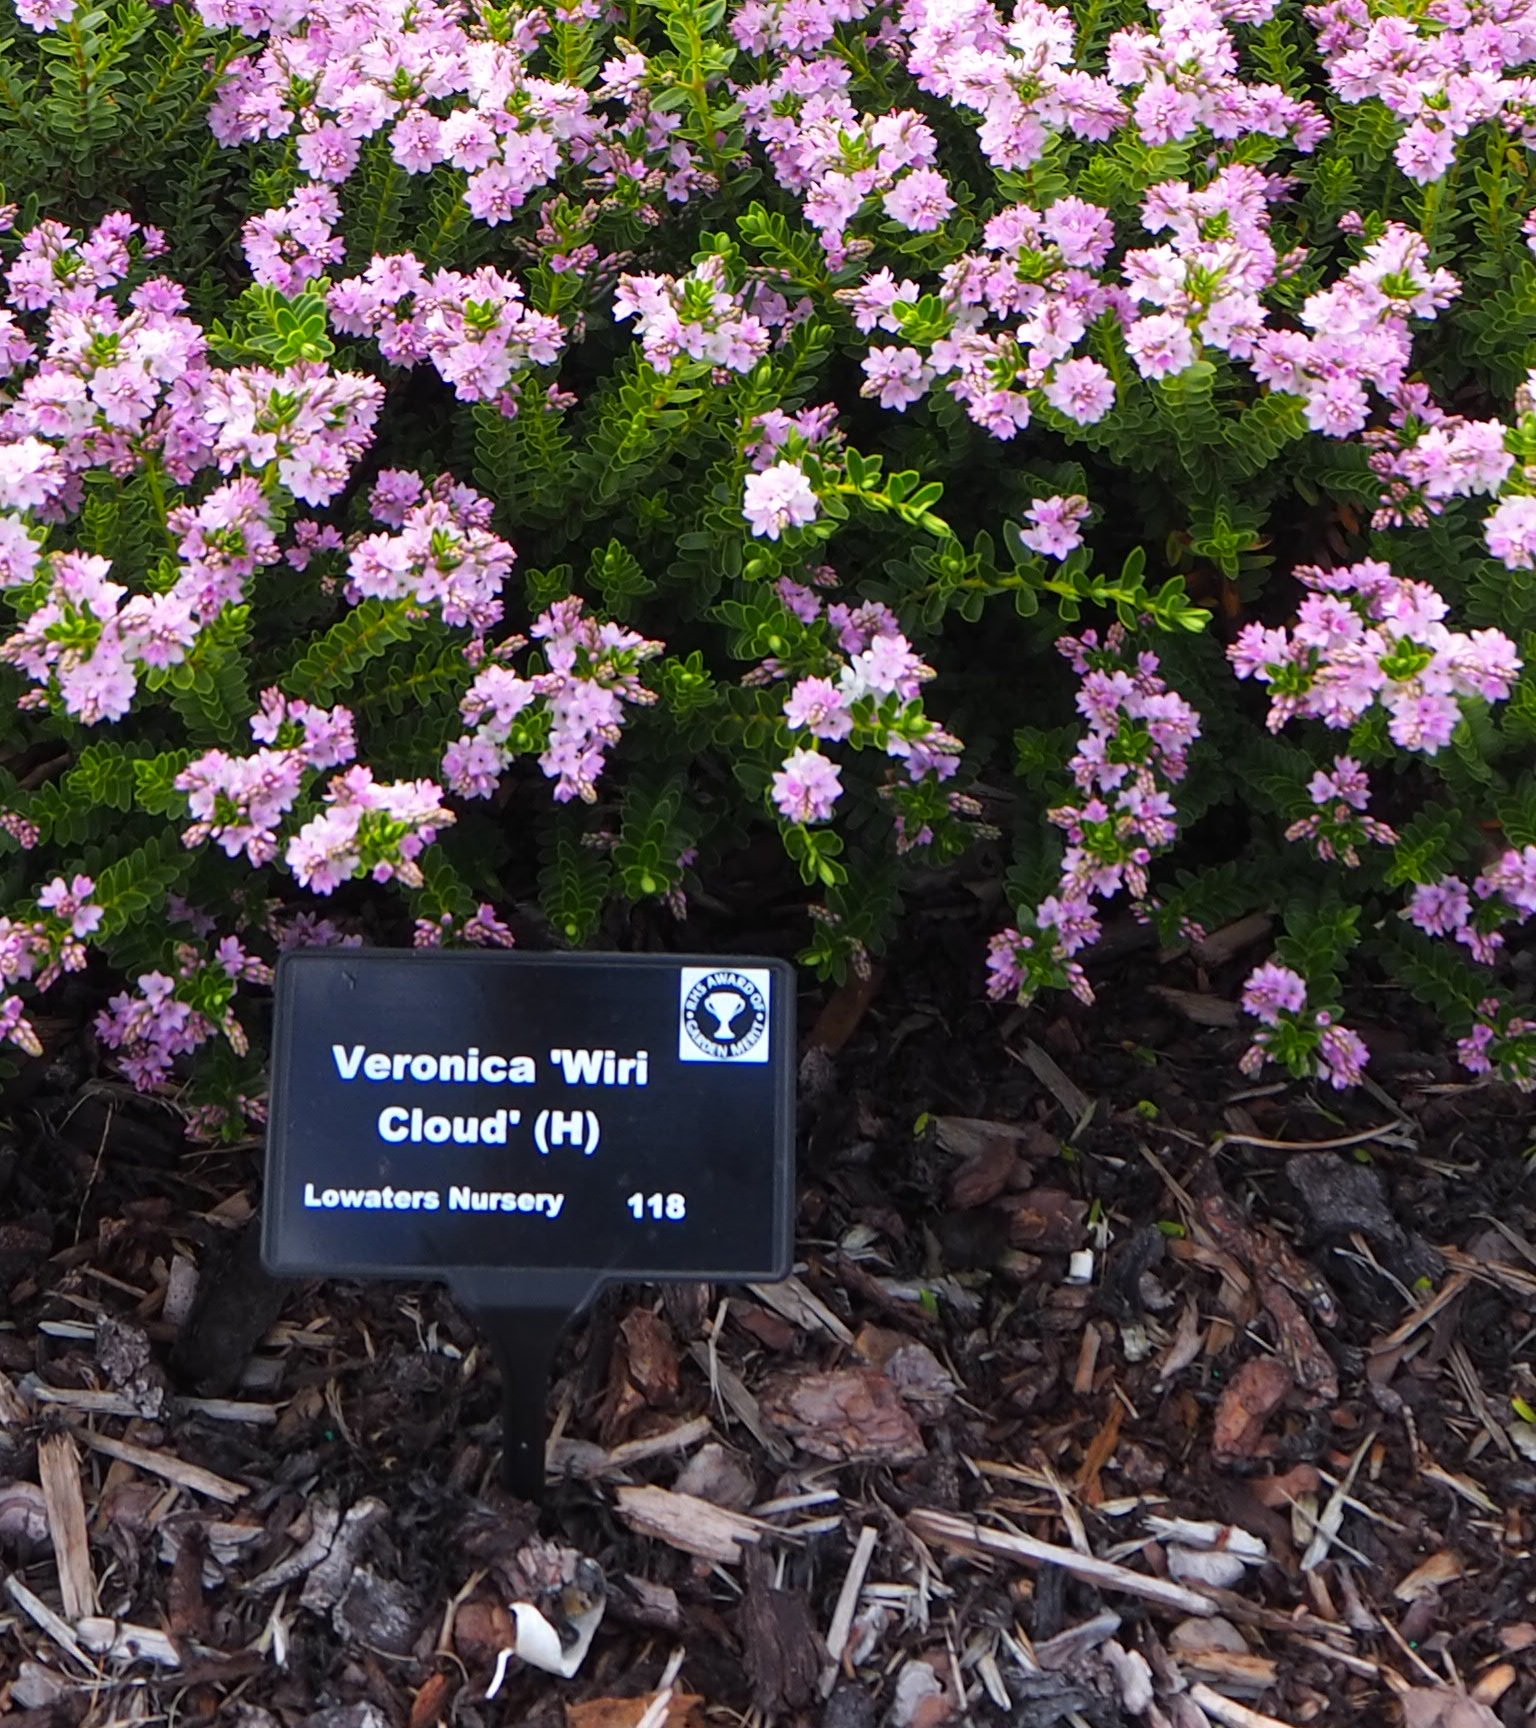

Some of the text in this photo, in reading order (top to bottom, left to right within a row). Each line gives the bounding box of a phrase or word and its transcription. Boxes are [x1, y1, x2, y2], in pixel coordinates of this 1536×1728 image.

[686, 982, 708, 1011] RHS
[706, 972, 756, 996] AWARD
[331, 1044, 648, 1086] Veronica 'Wiri
[377, 1105, 600, 1154] Cloud' (H)
[304, 1182, 687, 1221] Lowaters Nursery 118
